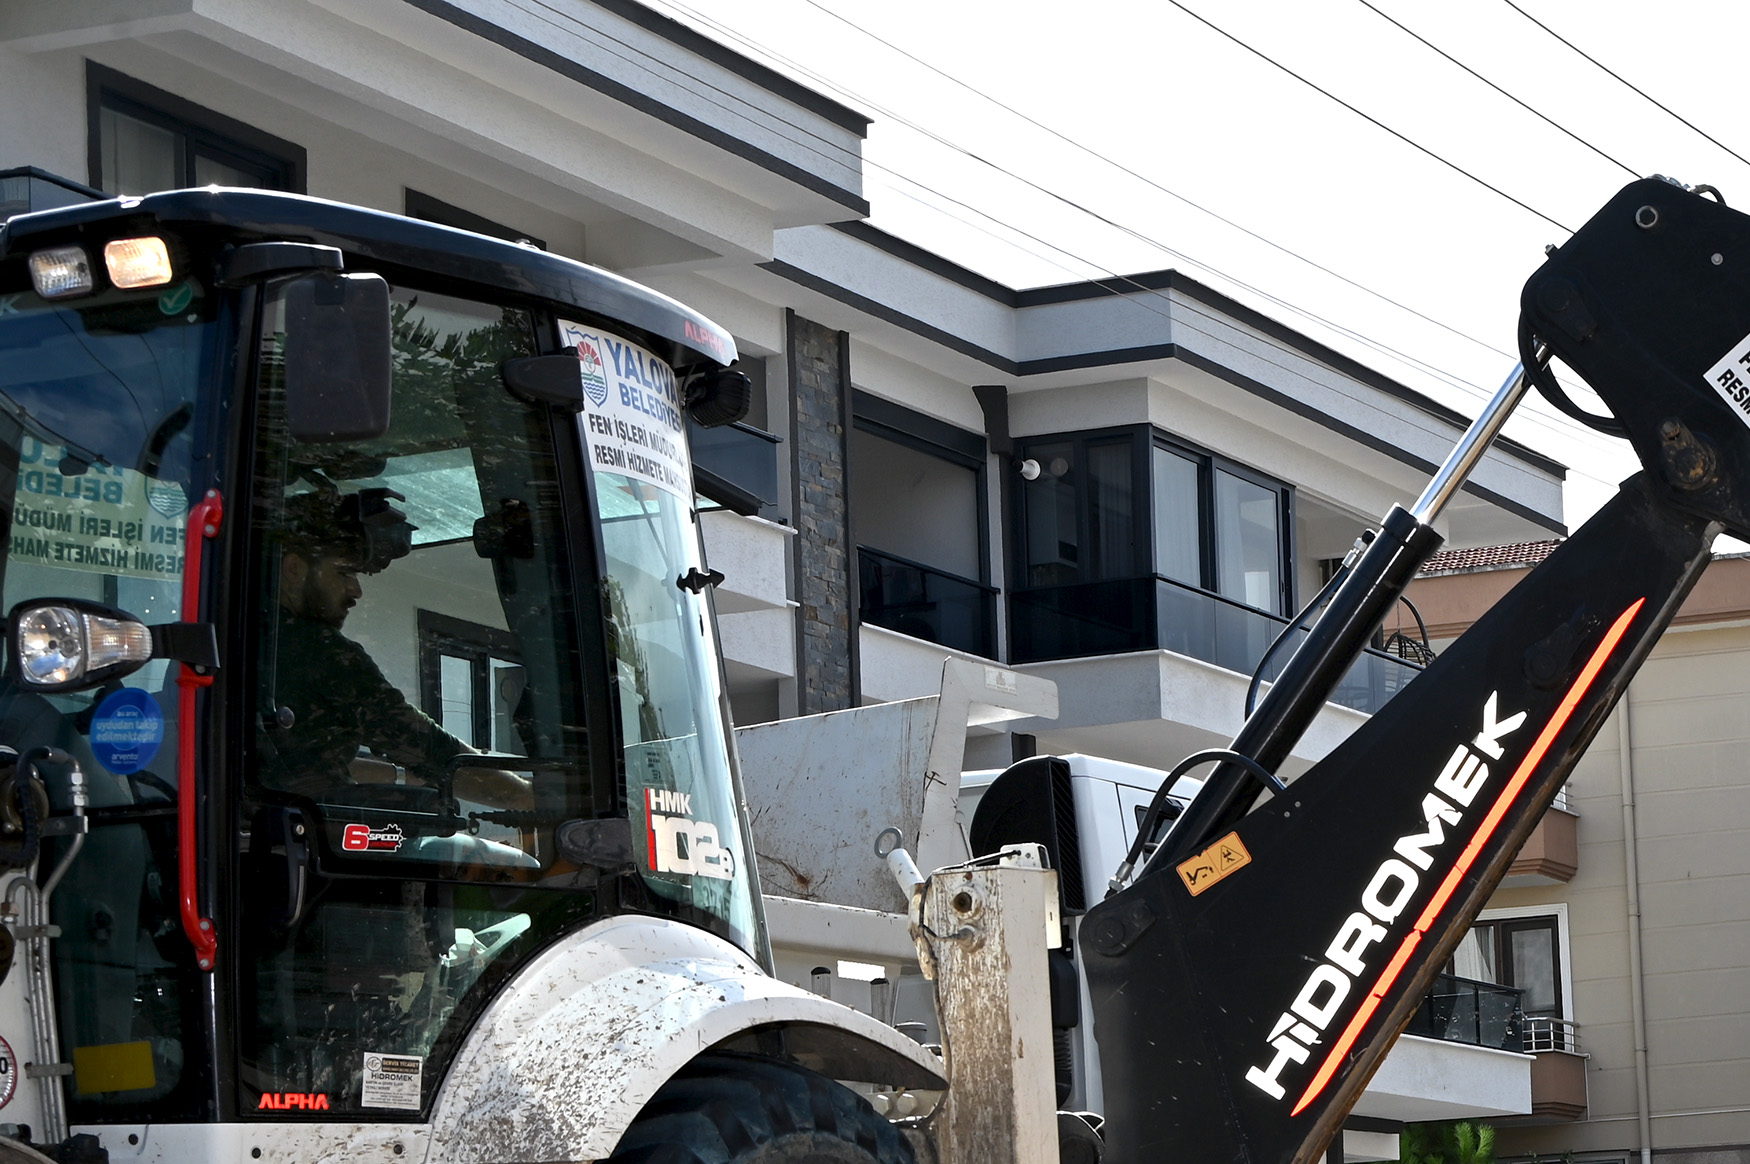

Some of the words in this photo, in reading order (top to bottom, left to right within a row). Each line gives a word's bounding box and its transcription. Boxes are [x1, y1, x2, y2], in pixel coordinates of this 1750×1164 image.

[684, 320, 727, 354] ALPHA
[604, 338, 680, 409] YALOVA
[588, 413, 613, 437] FEN
[613, 415, 648, 446] İŞLERİ
[594, 444, 626, 468] RESMİ
[627, 447, 664, 481] HİZMETE
[96, 720, 134, 731] uydudan
[96, 731, 156, 741] edilmektedir
[649, 788, 694, 815] HMK
[368, 833, 399, 841] SPEED
[258, 1093, 330, 1110] ALPHA
